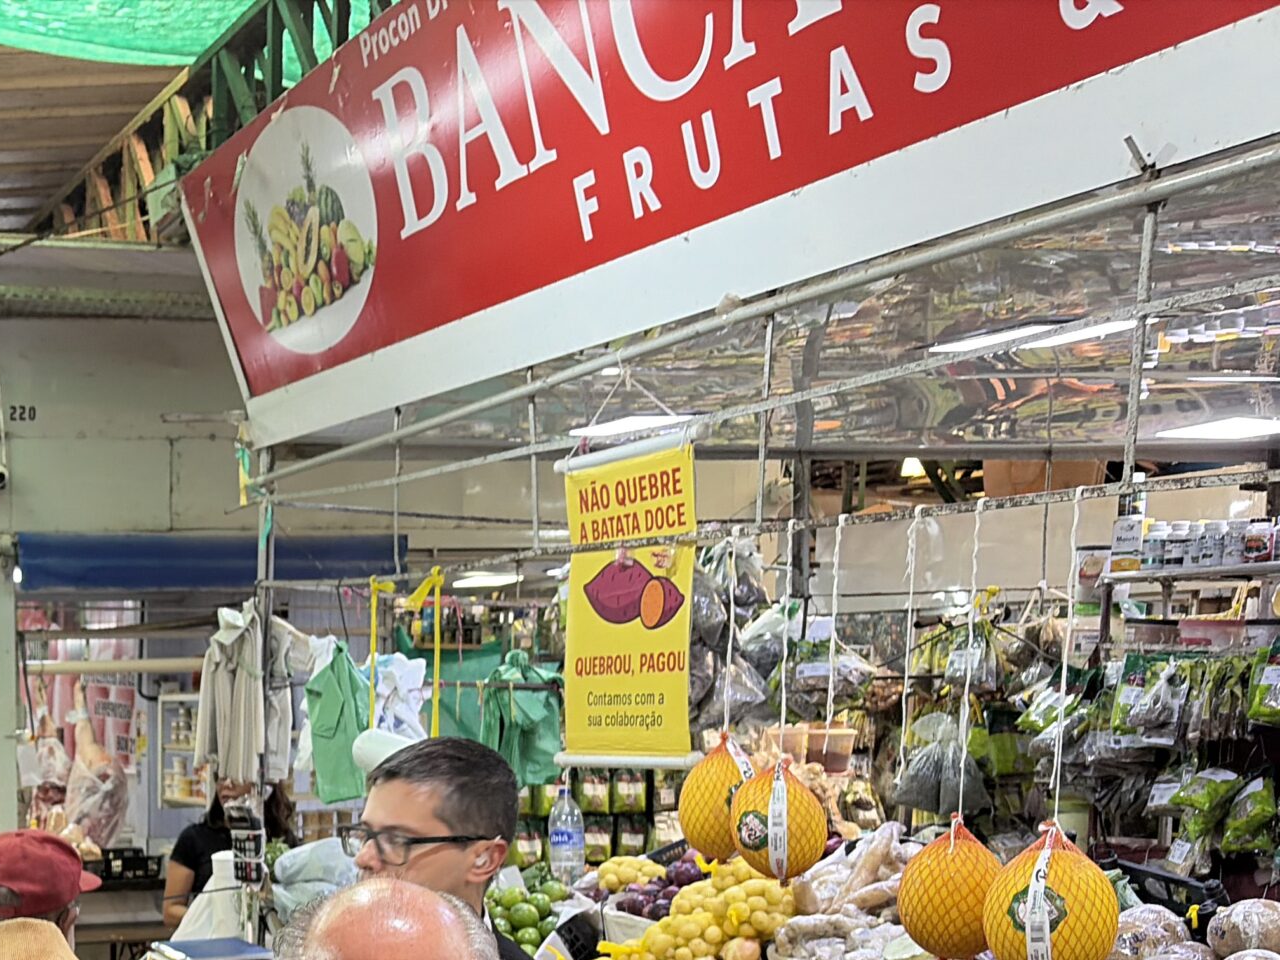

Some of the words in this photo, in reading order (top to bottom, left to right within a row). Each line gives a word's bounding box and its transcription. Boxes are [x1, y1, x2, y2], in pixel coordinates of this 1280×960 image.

[359, 3, 421, 68] Procon
[572, 4, 952, 241] FRUTAS
[9, 405, 36, 421] 220
[578, 480, 610, 514] NÃO
[615, 467, 683, 507] QUEBRE
[580, 521, 588, 544] A
[591, 512, 641, 543] BATATA
[644, 502, 687, 532] DOCE
[575, 653, 635, 678] QUEBROU,
[639, 650, 686, 673] PAGOU
[587, 691, 632, 706] Contamos
[634, 692, 655, 705] com
[658, 692, 665, 705] a
[587, 714, 602, 727] sua
[605, 710, 663, 731] colaboração
